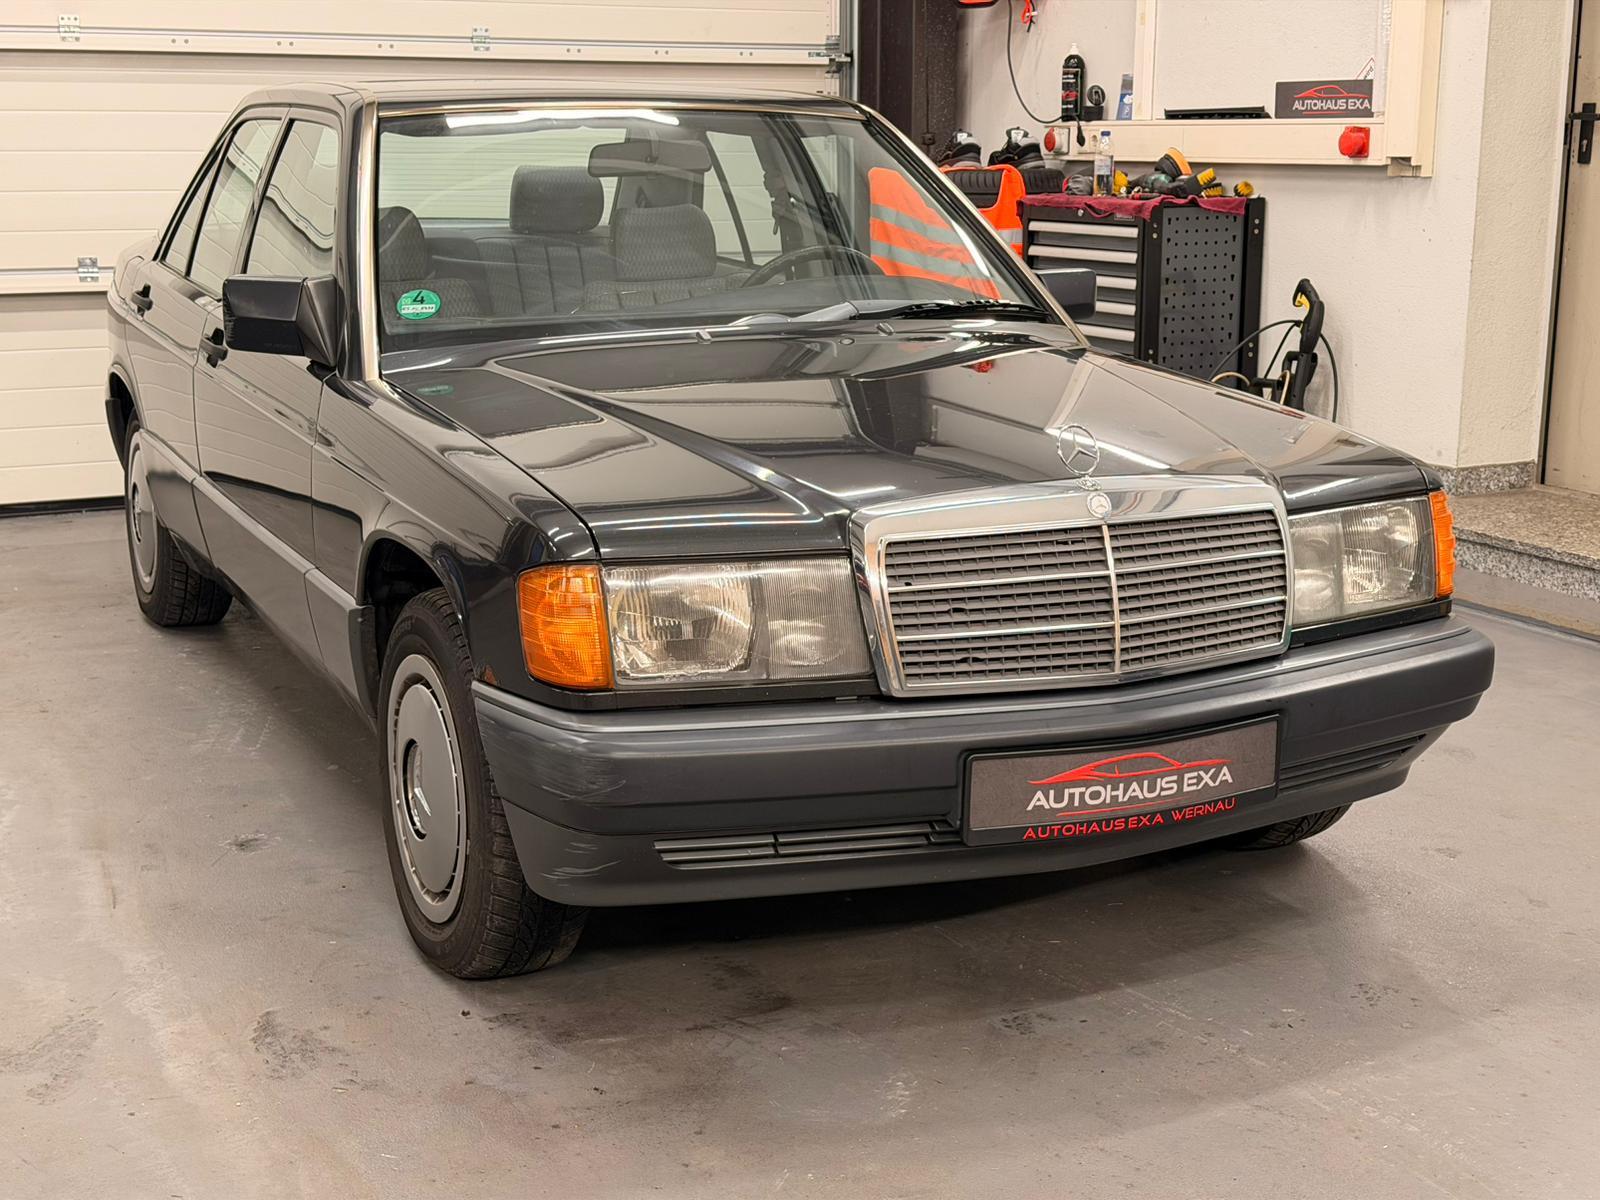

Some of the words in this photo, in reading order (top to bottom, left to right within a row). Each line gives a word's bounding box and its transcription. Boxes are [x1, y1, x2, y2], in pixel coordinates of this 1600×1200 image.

[1292, 99, 1346, 110] AUTOHAUS
[1348, 98, 1371, 110] EXA
[412, 290, 425, 304] 4
[1026, 775, 1177, 811] AUTOHAUS
[1183, 766, 1233, 792] EXA
[1023, 818, 1125, 840] AUTOHAUS
[1128, 813, 1164, 828] EXA
[1171, 798, 1235, 822] WERNAU
